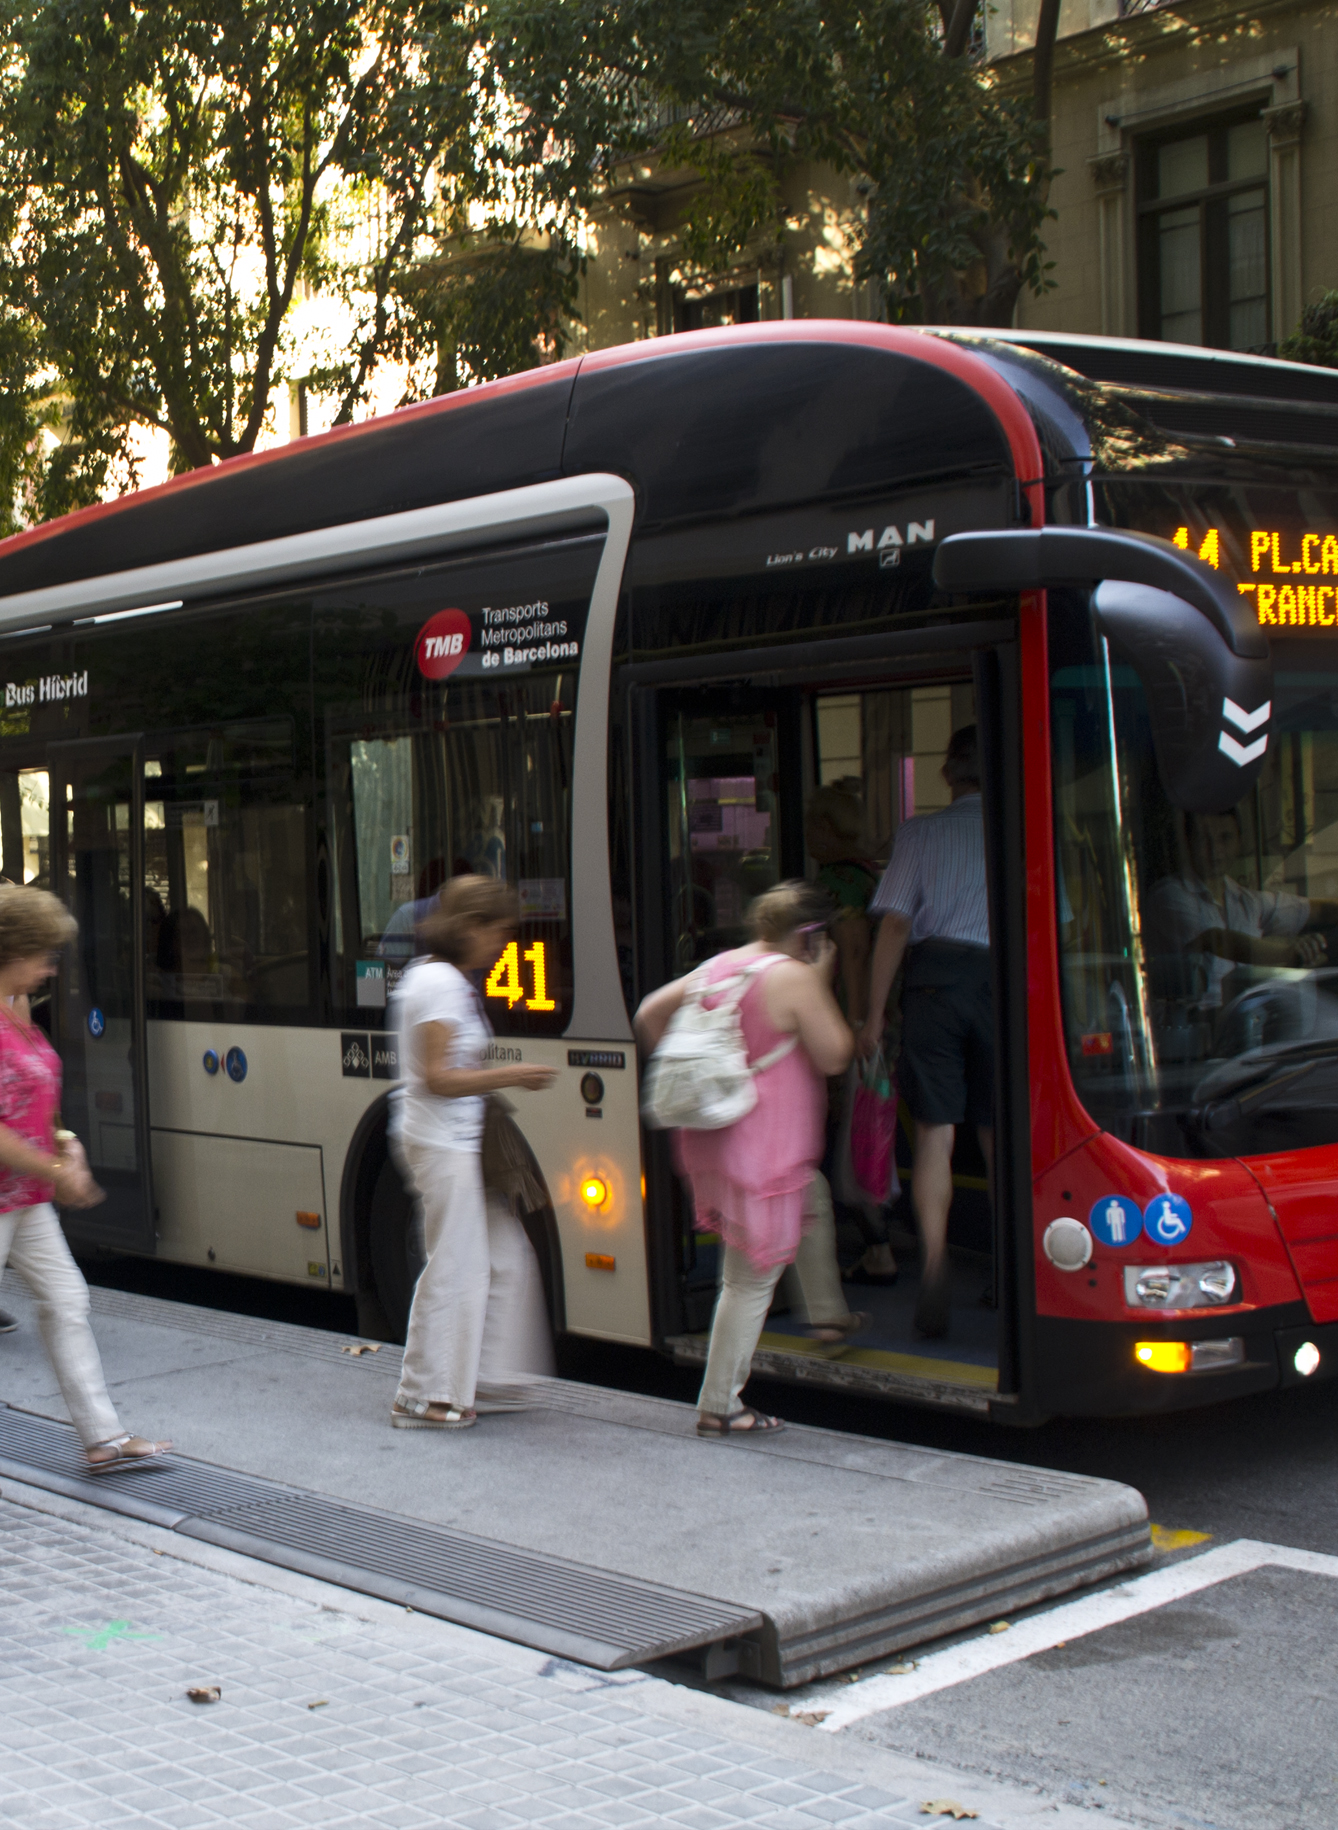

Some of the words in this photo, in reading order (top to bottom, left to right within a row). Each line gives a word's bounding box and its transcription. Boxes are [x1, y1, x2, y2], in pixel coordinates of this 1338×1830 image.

[847, 519, 935, 554] MAN
[766, 551, 804, 567] Lion's
[808, 546, 839, 560] City
[482, 600, 549, 626] Transports
[424, 633, 464, 660] TMB
[481, 620, 568, 648] Metropolitans
[481, 650, 500, 669] de
[503, 641, 579, 666] Barcelona
[5, 682, 35, 708] Bus
[365, 966, 384, 979] ATM
[486, 941, 556, 1012] 41
[374, 1050, 397, 1066] AMB
